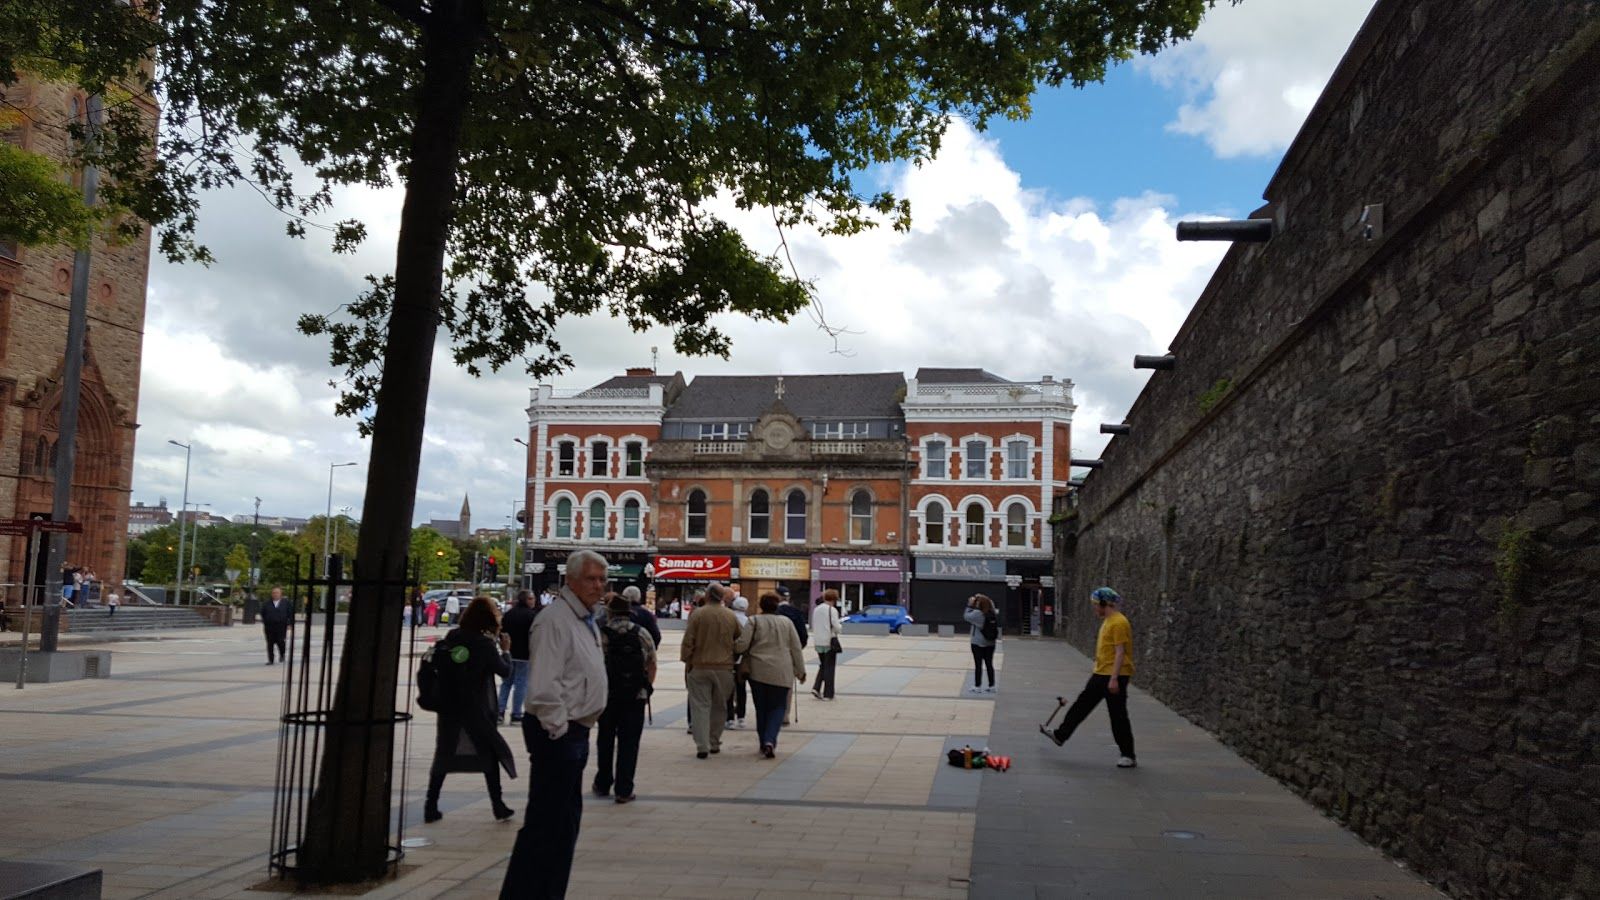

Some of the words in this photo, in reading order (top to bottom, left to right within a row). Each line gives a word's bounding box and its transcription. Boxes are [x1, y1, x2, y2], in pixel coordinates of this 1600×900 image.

[618, 553, 635, 561] BAR
[821, 557, 838, 566] The
[839, 557, 872, 567] Pickled
[874, 558, 898, 567] Duck
[658, 557, 714, 568] Samara's
[932, 559, 991, 578] Dooley's
